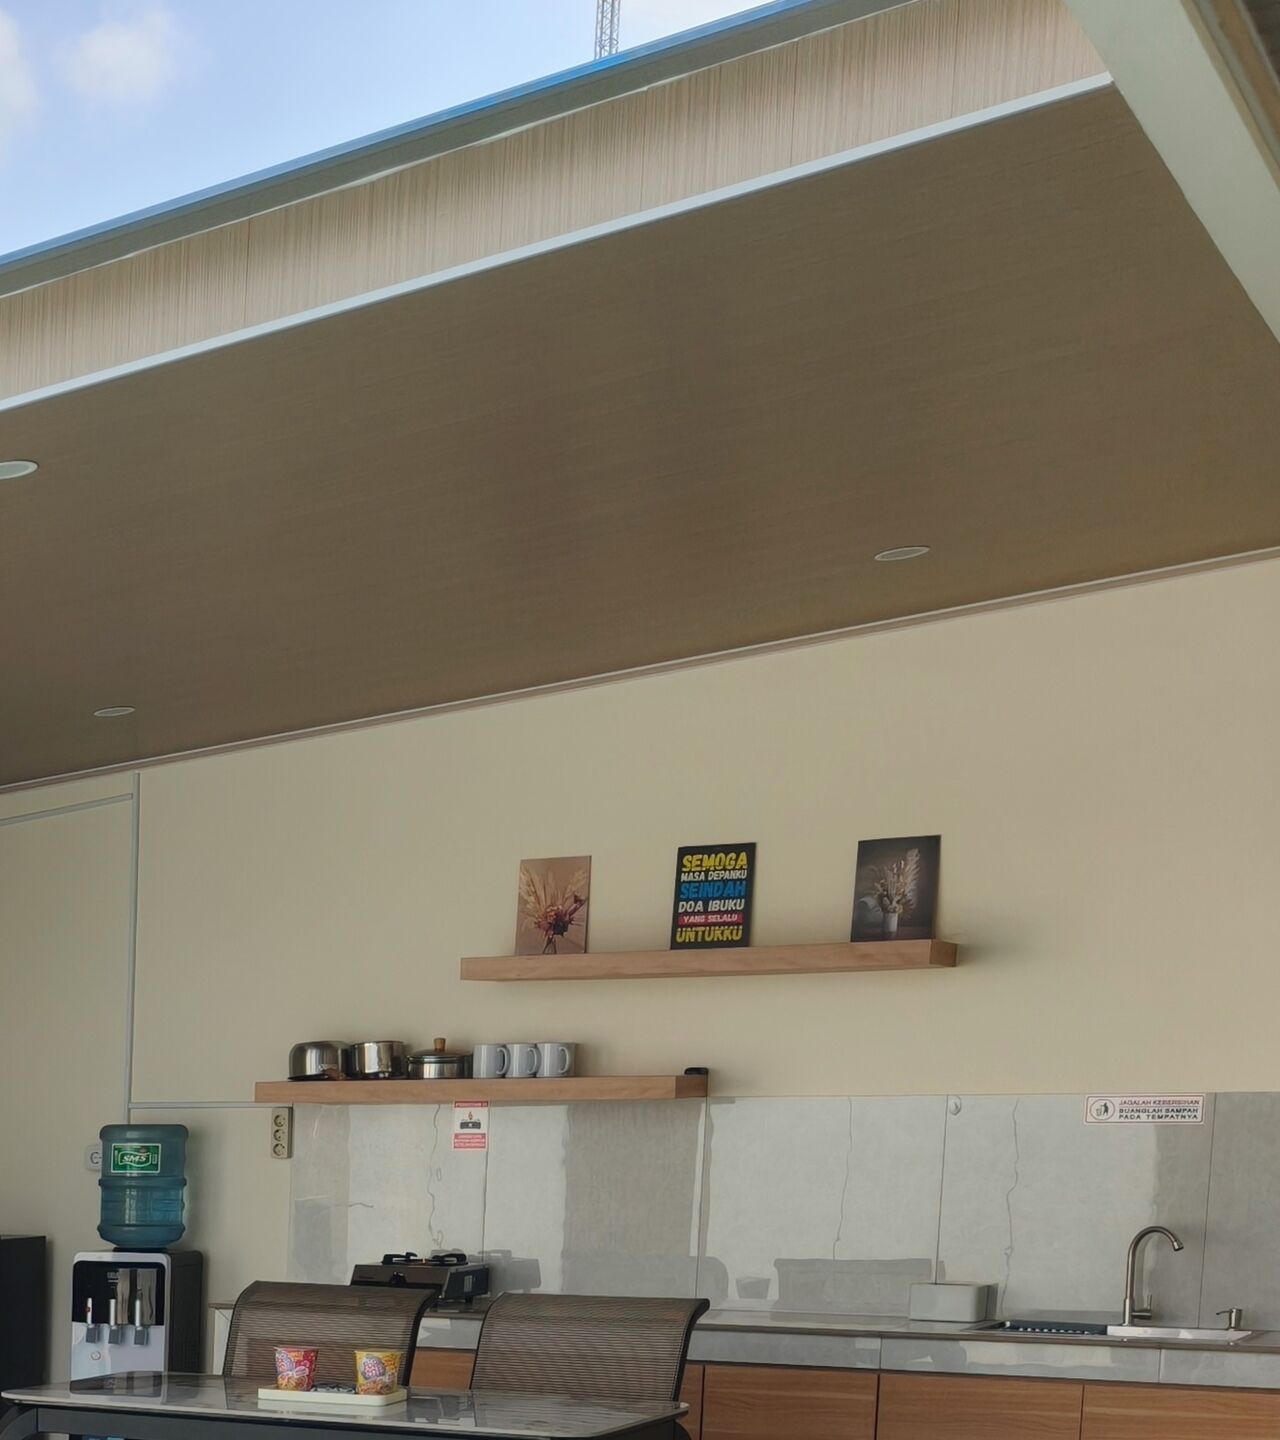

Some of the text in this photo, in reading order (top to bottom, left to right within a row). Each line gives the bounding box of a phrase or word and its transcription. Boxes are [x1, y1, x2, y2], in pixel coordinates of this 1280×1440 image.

[682, 852, 748, 871] SEMOGA
[680, 869, 748, 882] MASA DEPANKU
[680, 881, 747, 899] SEINDAH
[678, 898, 745, 913] DOA IBUKU
[683, 913, 738, 924] YANG SELALU
[675, 925, 743, 943] UNTUKKU
